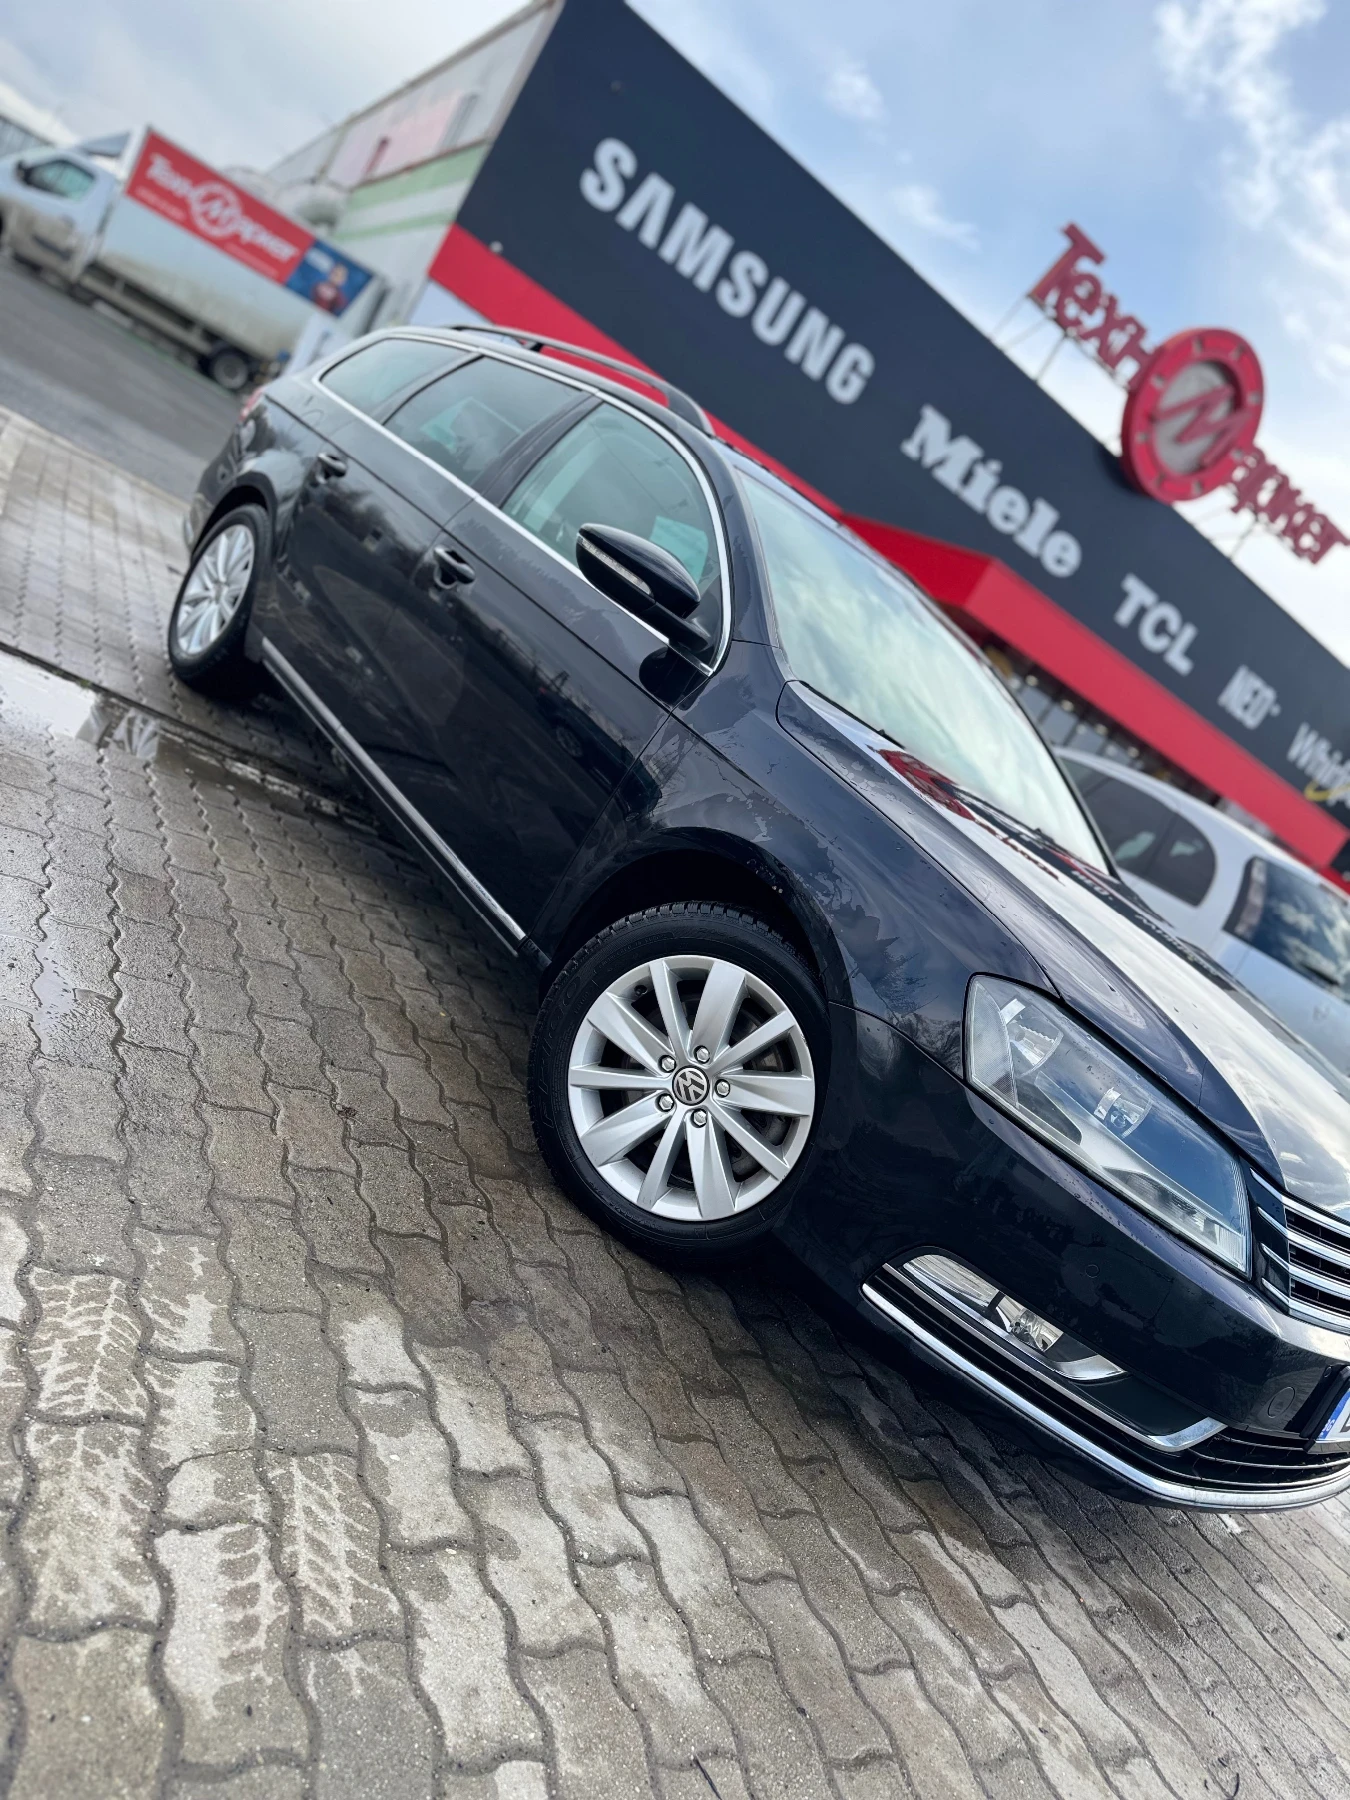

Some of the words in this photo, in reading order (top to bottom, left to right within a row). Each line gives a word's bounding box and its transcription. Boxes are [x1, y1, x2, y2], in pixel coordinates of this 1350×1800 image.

[579, 137, 875, 405] SAMSUNG
[900, 404, 1082, 578] Miele
[1114, 573, 1198, 676] TCL
